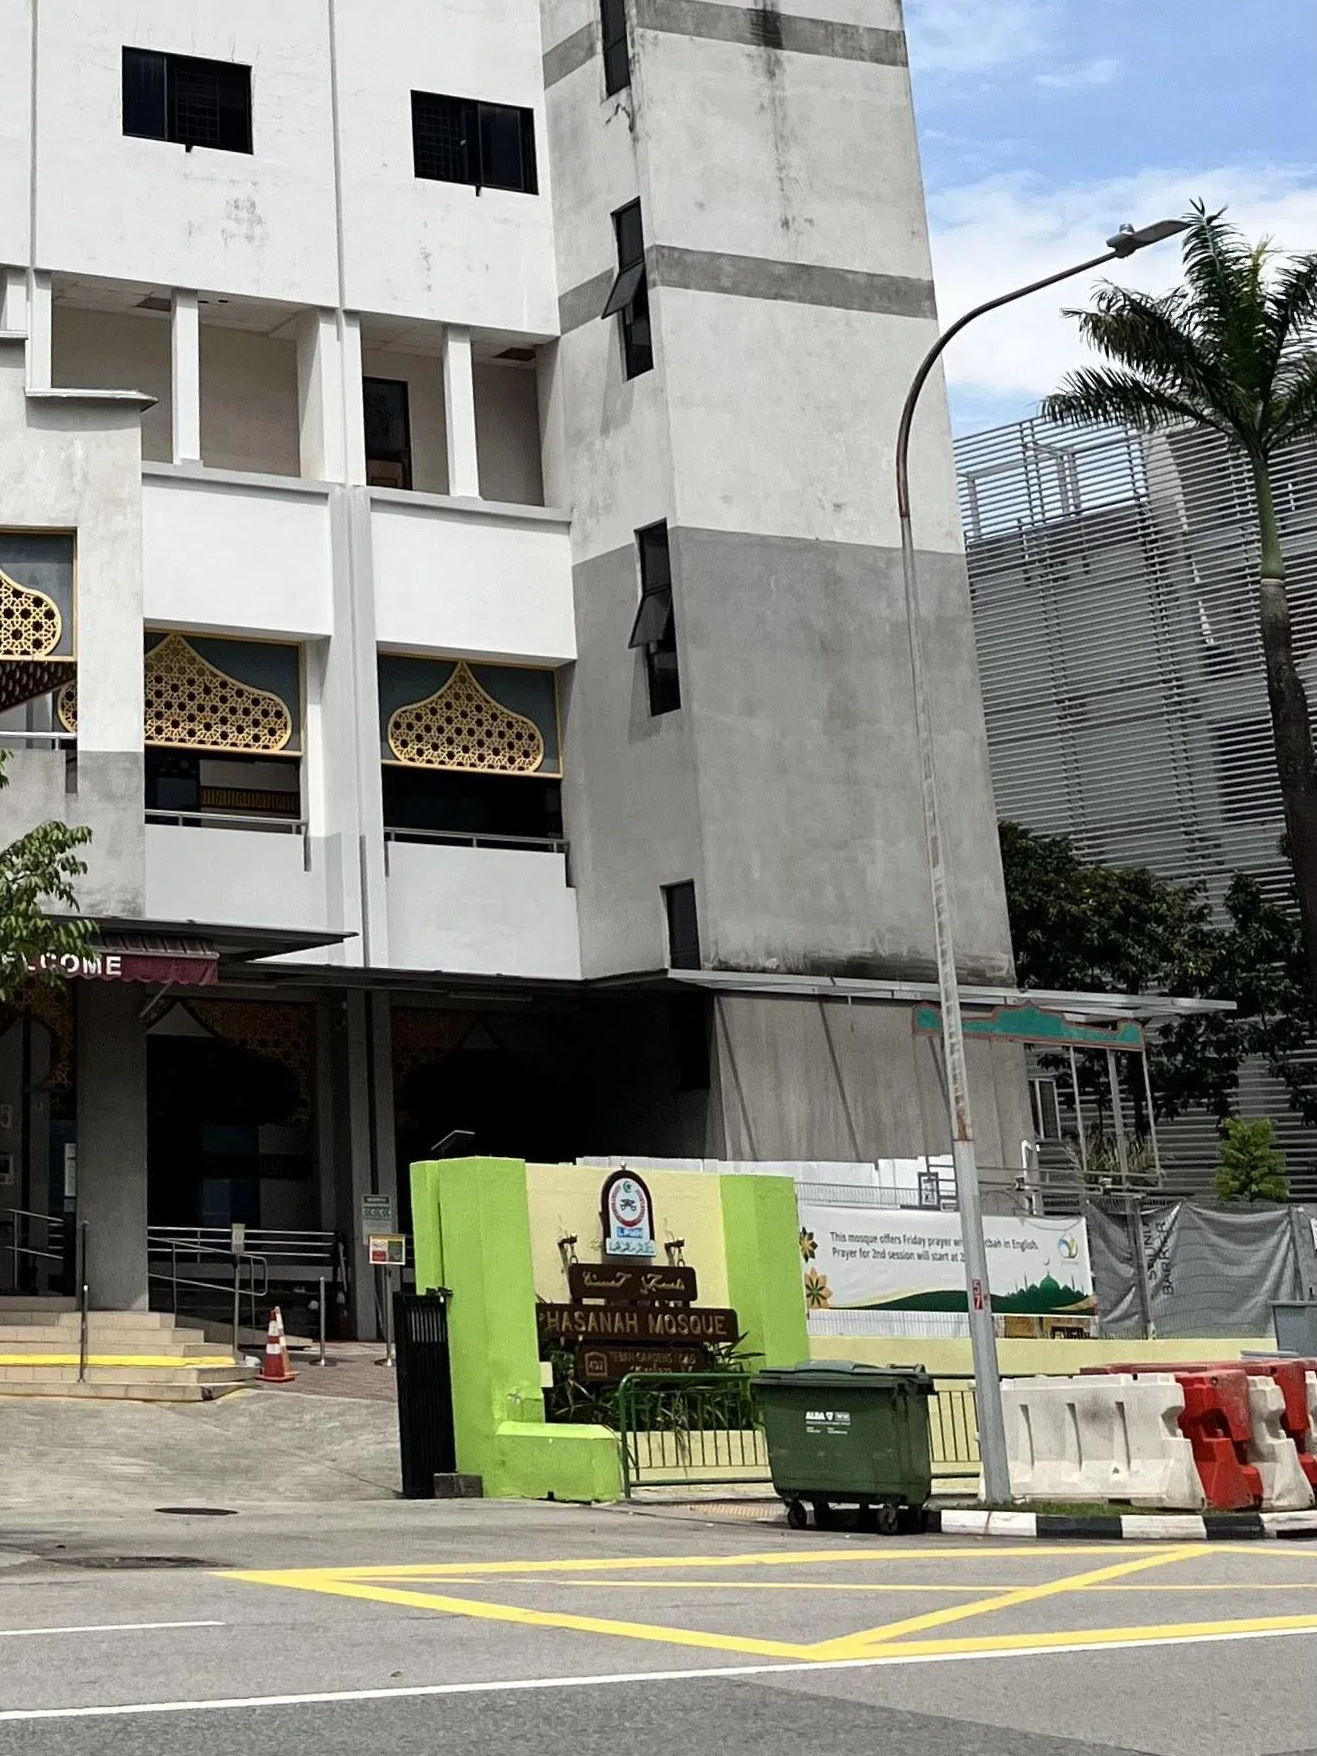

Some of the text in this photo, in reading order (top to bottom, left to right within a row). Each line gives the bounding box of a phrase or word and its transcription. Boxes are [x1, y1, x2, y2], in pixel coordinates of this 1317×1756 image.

[830, 1231, 847, 1243] This
[848, 1234, 878, 1246] mosque
[879, 1233, 902, 1245] offers
[903, 1234, 926, 1248] Friday
[927, 1237, 952, 1249] prayer
[1003, 1239, 1011, 1248] in
[832, 1247, 857, 1261] Prayer
[859, 1247, 870, 1259] for
[872, 1248, 886, 1259] 2nd
[888, 1249, 915, 1261] session
[916, 1250, 930, 1261] will
[931, 1251, 949, 1262] start
[951, 1252, 958, 1262] at
[547, 1311, 727, 1336] HASANAH MOSQUE
